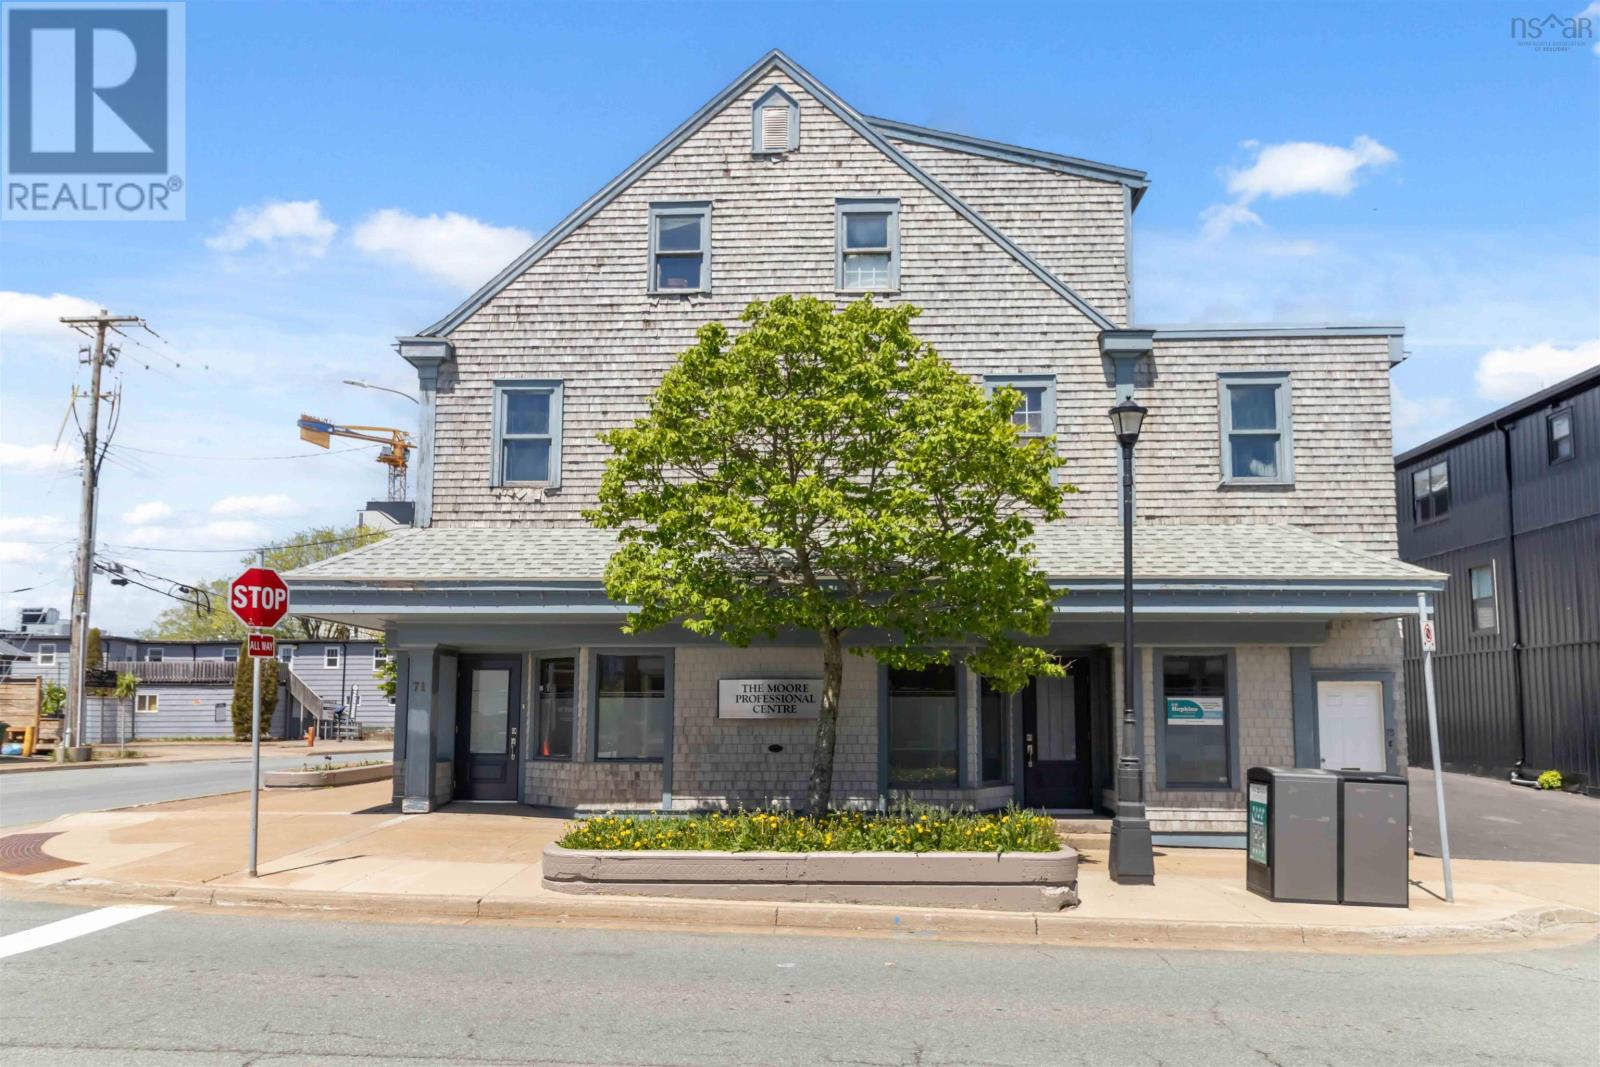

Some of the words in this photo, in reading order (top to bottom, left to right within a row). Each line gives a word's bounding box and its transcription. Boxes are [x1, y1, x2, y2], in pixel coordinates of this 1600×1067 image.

[233, 584, 286, 611] STOP
[249, 641, 261, 651] ALL
[261, 641, 273, 652] WAY
[412, 681, 426, 692] 71
[741, 684, 764, 693] THE
[767, 683, 810, 693] MOORE
[735, 694, 816, 704] PROFESSIONAL
[752, 704, 798, 714] CENTRE
